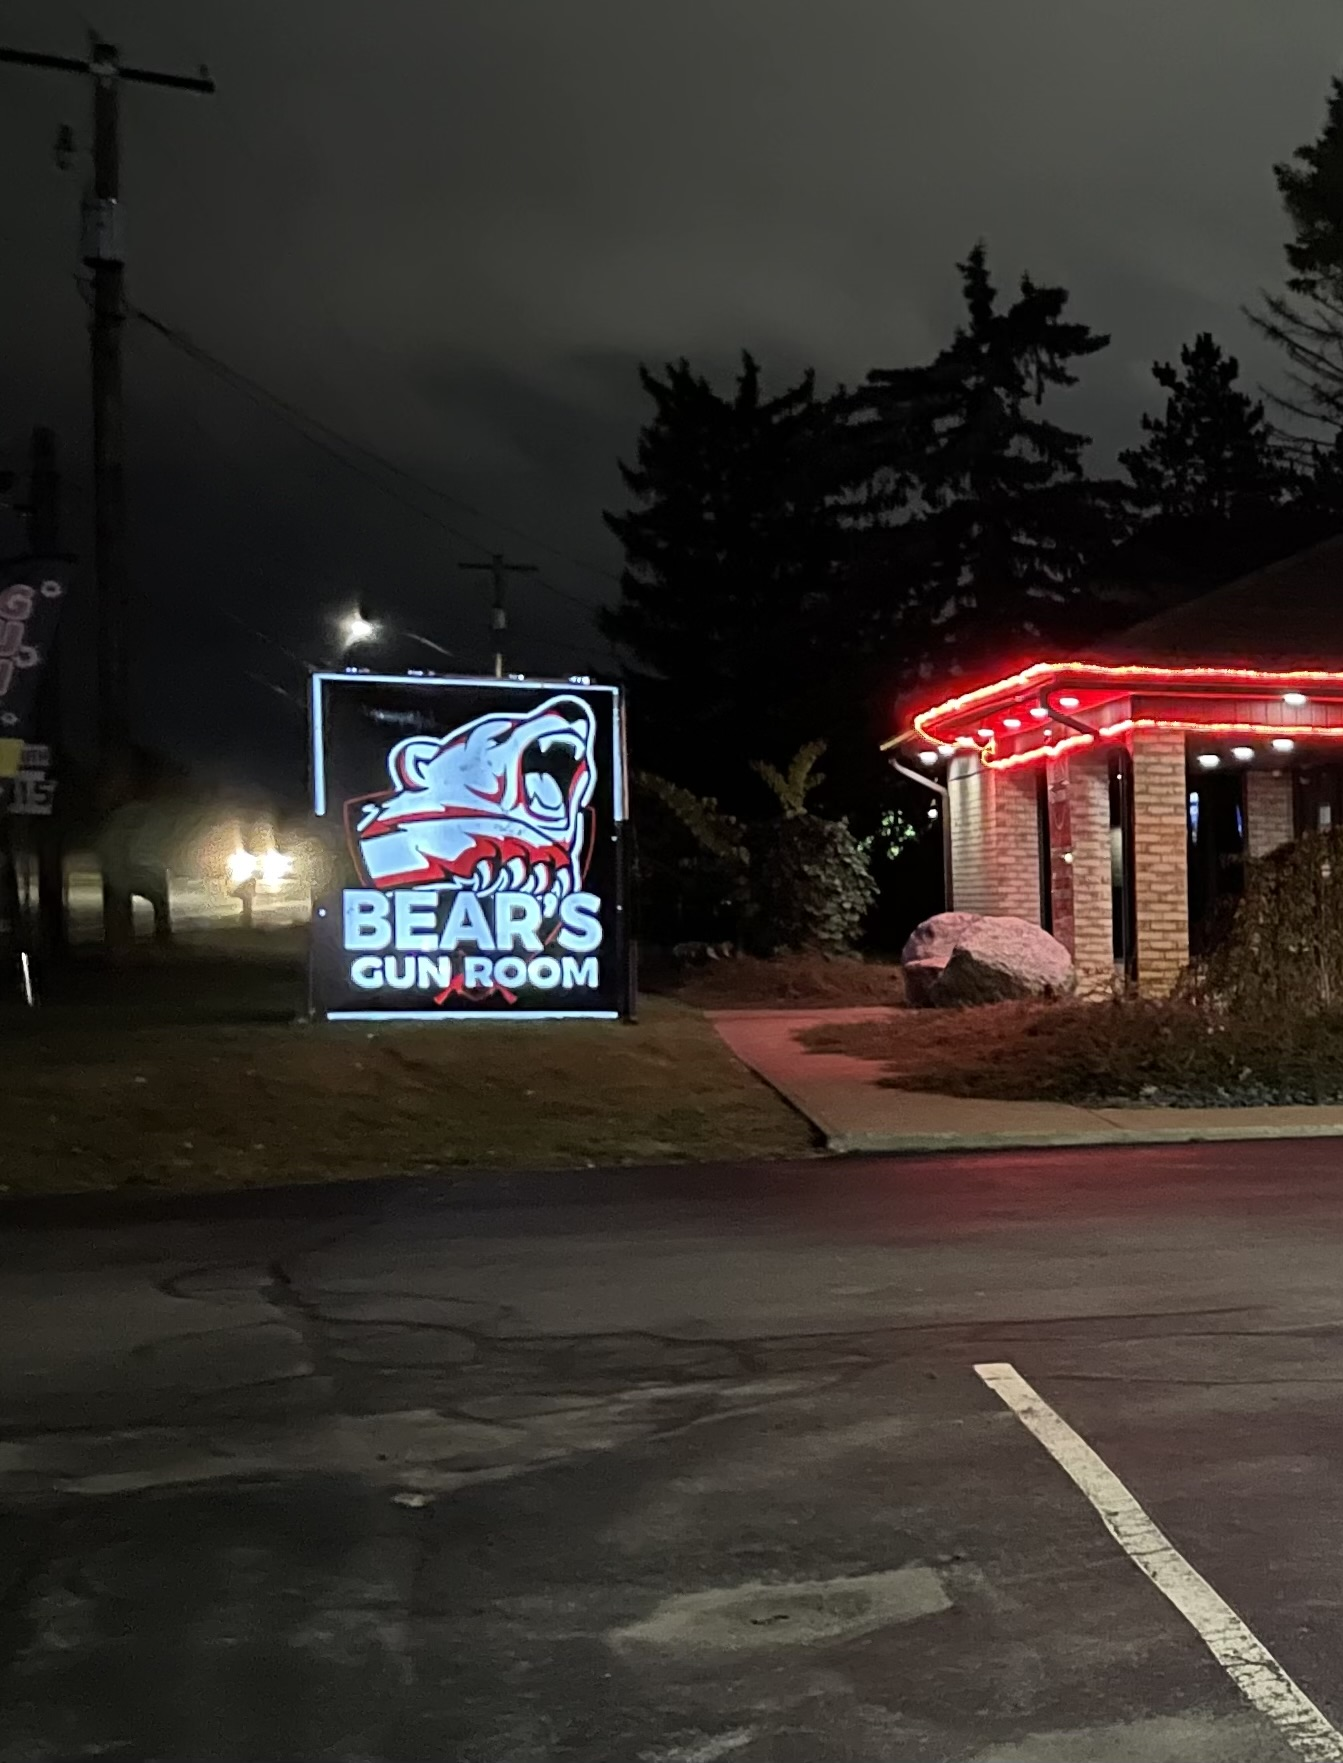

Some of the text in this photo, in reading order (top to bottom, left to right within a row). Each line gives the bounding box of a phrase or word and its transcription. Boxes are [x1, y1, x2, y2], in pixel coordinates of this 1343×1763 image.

[343, 890, 603, 951] BEAR'S
[351, 956, 599, 988] GUN ROOM
